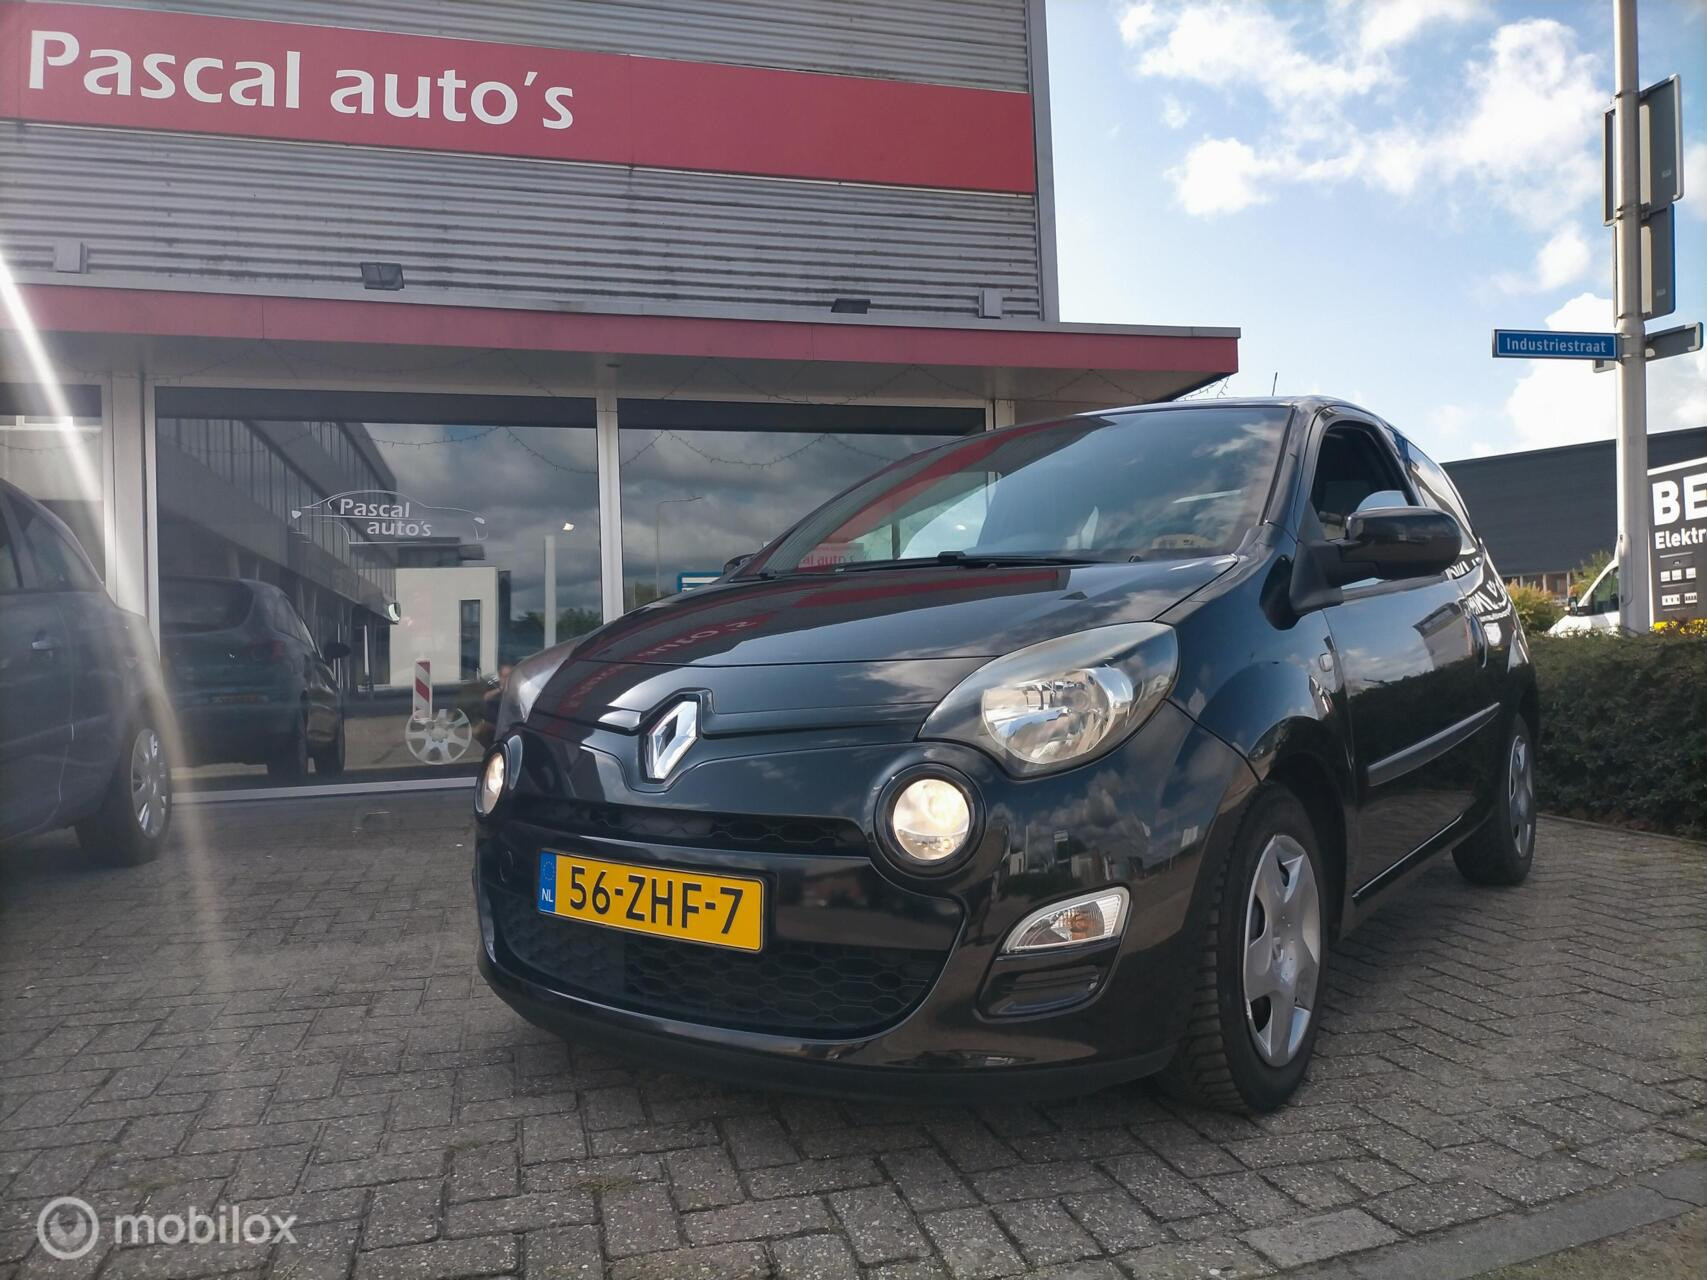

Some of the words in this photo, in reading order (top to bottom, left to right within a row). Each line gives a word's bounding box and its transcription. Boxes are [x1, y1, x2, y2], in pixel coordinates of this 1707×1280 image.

[28, 30, 301, 108] Pascal
[330, 69, 575, 130] auto's
[1506, 337, 1606, 353] Industriestraat
[340, 498, 409, 518] Pascal
[366, 520, 432, 537] auto's
[541, 888, 553, 902] NL
[570, 865, 743, 934] 56-ZHF-7
